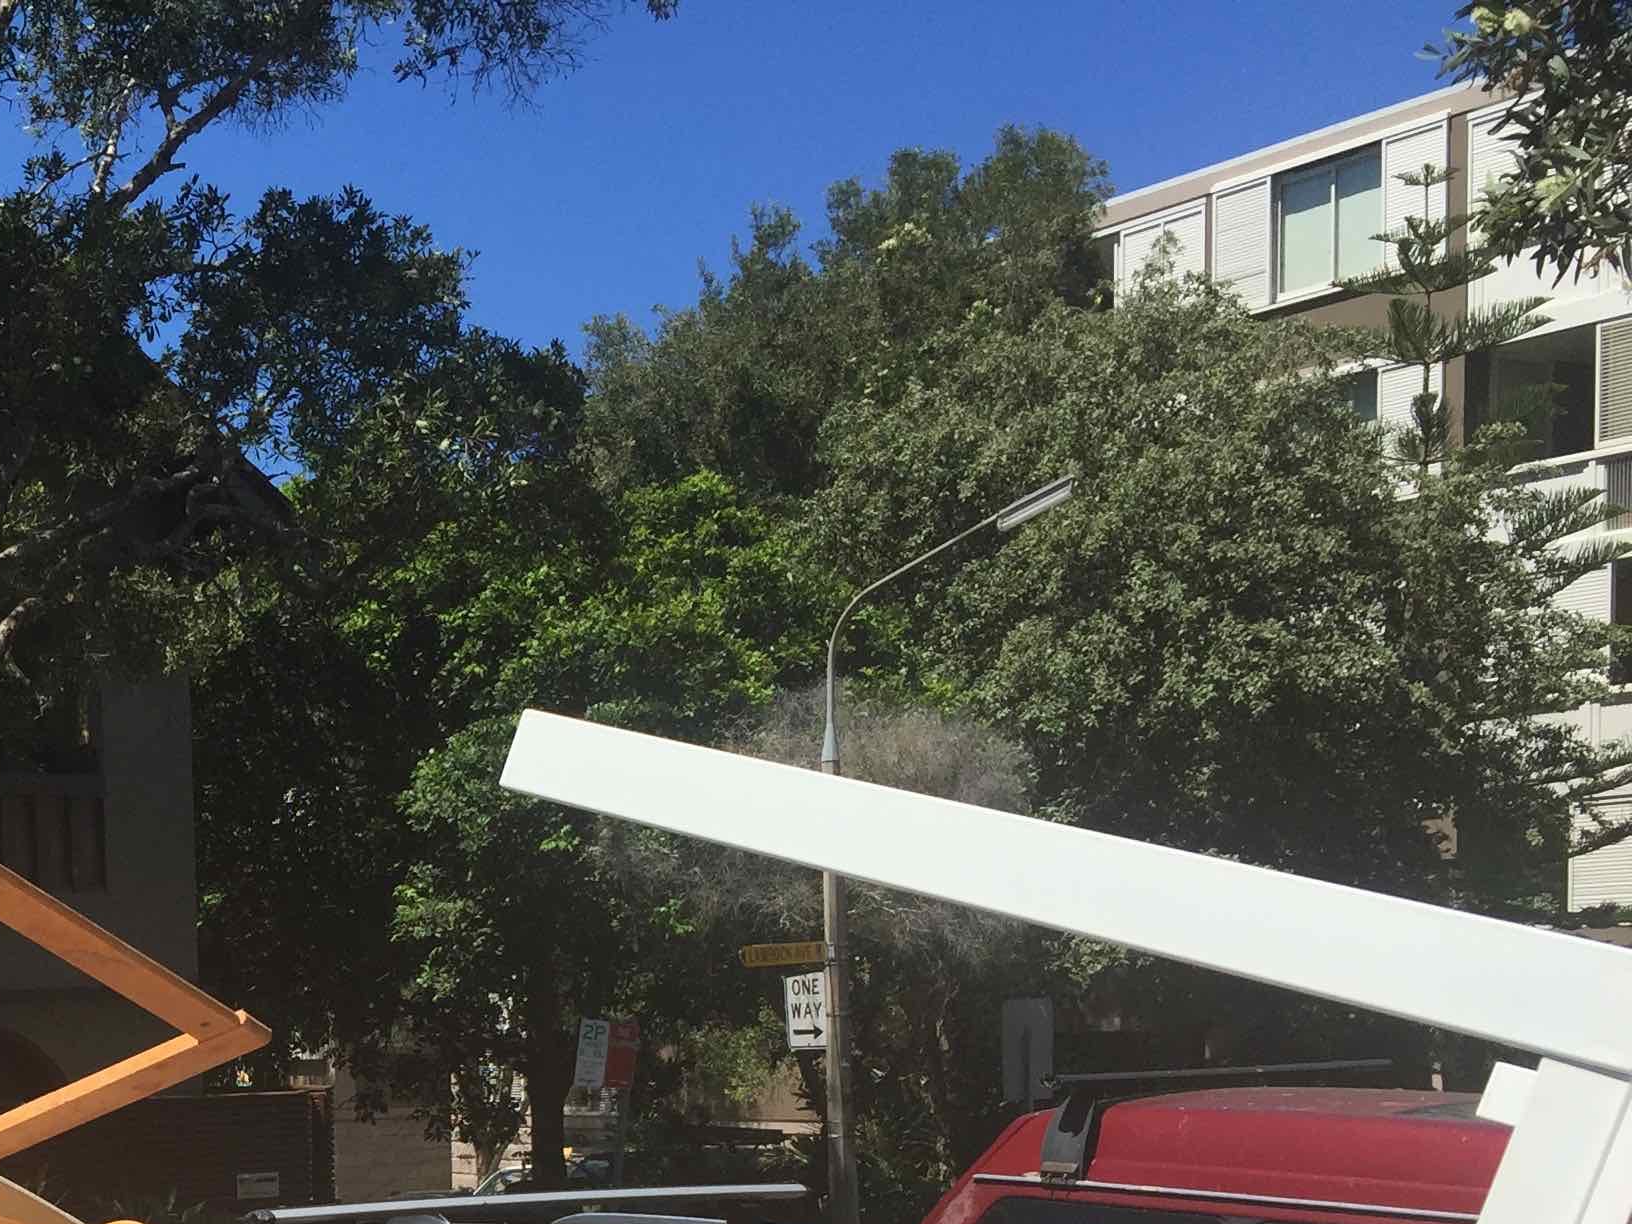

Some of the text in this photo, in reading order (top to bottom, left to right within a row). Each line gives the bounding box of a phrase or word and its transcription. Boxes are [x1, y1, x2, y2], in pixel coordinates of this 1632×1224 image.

[792, 978, 819, 995] ONE
[791, 1002, 822, 1019] WAY
[583, 1022, 607, 1041] 2P
